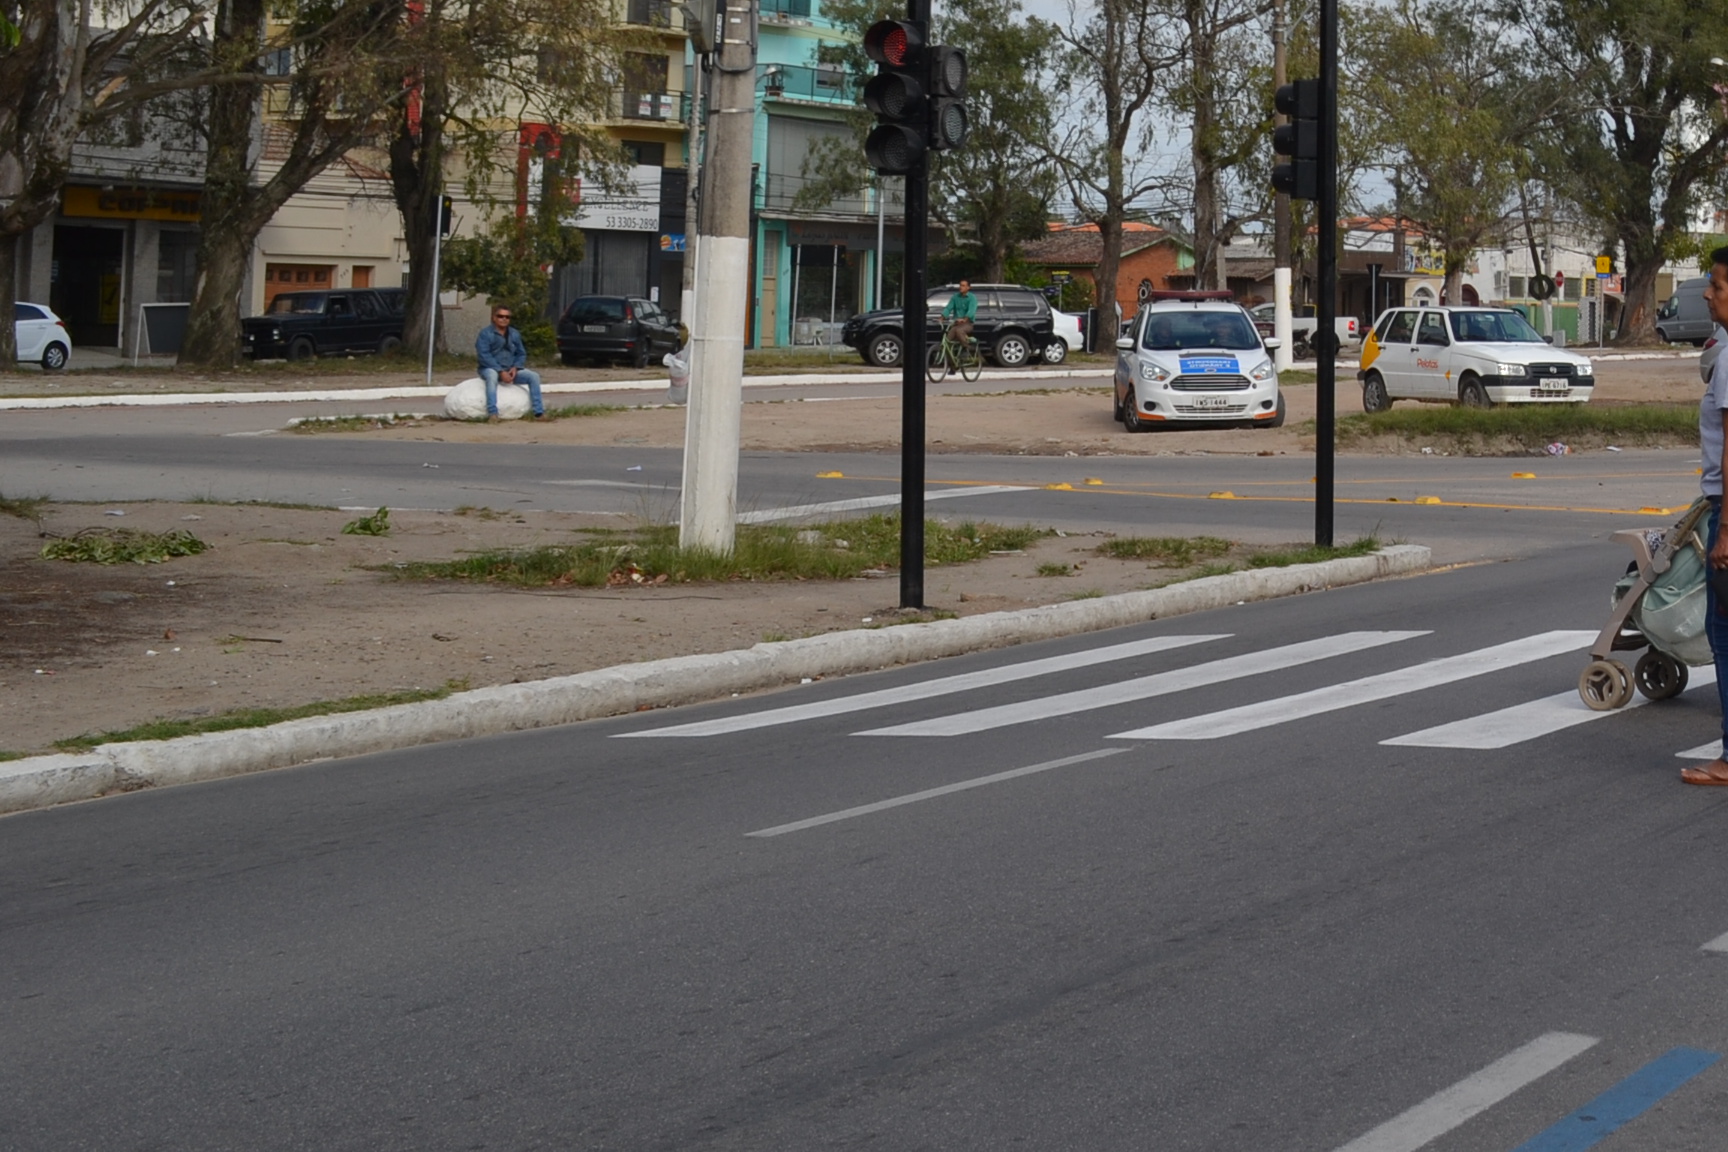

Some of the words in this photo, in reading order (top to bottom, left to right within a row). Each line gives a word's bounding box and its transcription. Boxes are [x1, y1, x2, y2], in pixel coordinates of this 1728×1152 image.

[605, 216, 616, 227] 53
[617, 217, 658, 230] 3305-2890
[1416, 358, 1439, 368] Pelotas
